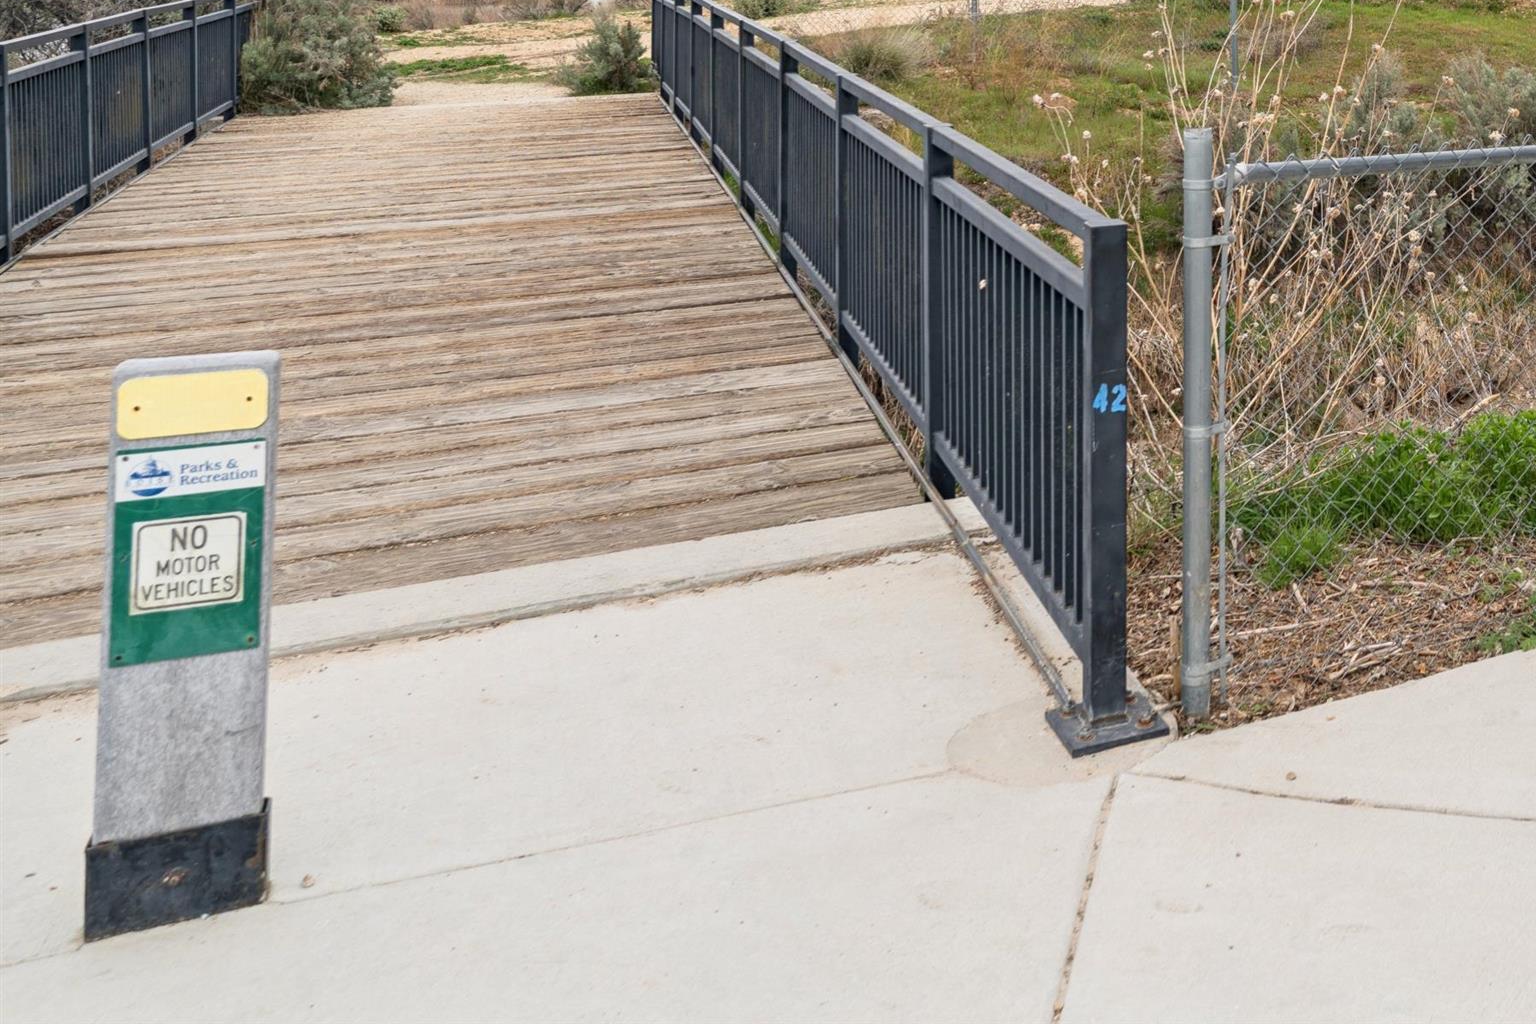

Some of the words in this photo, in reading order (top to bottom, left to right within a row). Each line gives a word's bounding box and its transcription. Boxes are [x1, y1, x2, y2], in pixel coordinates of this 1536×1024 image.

[1092, 383, 1127, 413] 42
[180, 460, 221, 474] Parks
[226, 458, 239, 469] &
[180, 468, 258, 486] Recreation
[171, 524, 208, 552] NO
[156, 554, 220, 577] MOTOR
[141, 575, 234, 602] VEHICLES
